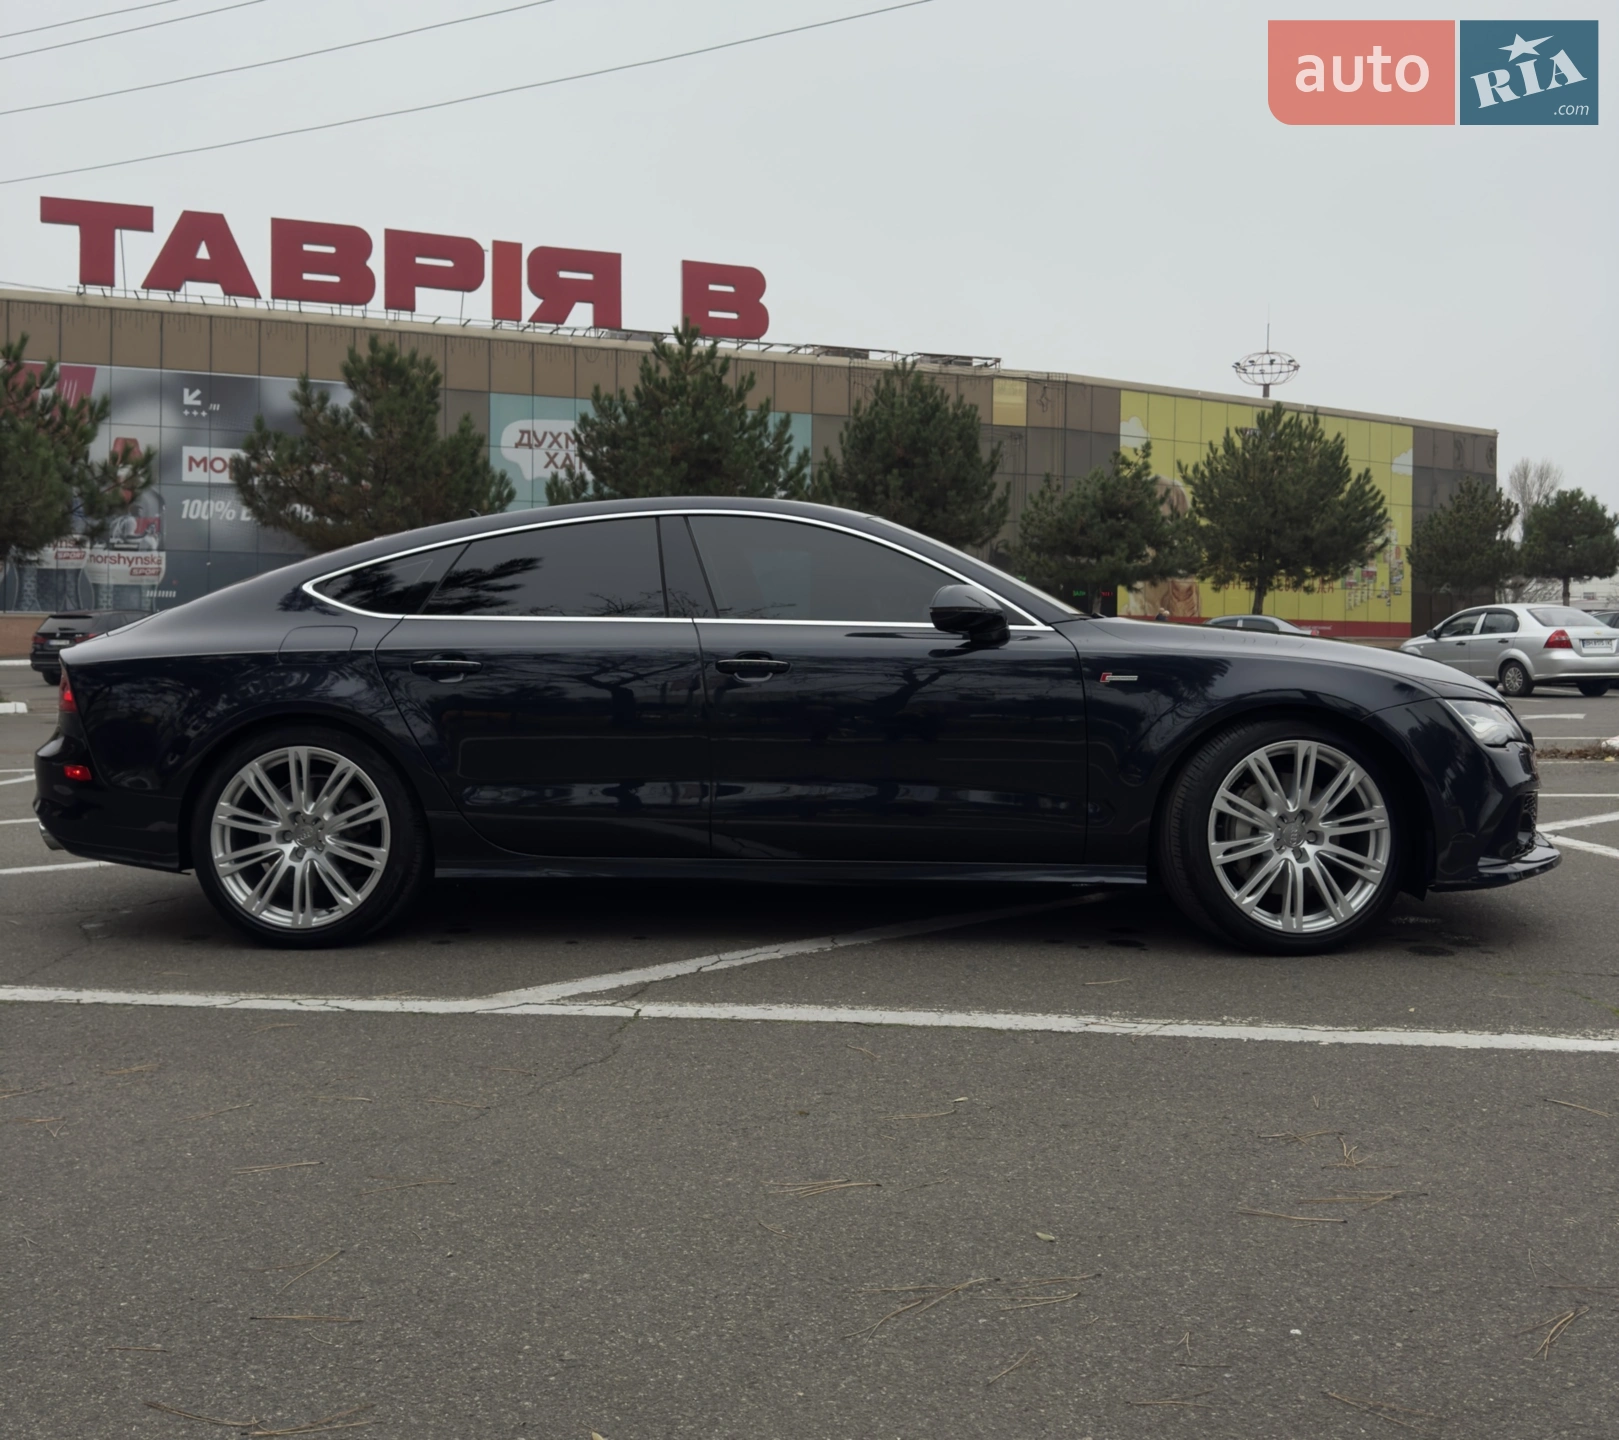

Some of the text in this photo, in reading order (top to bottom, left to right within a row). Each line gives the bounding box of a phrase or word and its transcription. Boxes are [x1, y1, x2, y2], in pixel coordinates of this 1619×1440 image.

[40, 196, 770, 340] ТАВРІЯ В
[514, 428, 578, 450] ДУХМ
[181, 499, 237, 521] 100%
